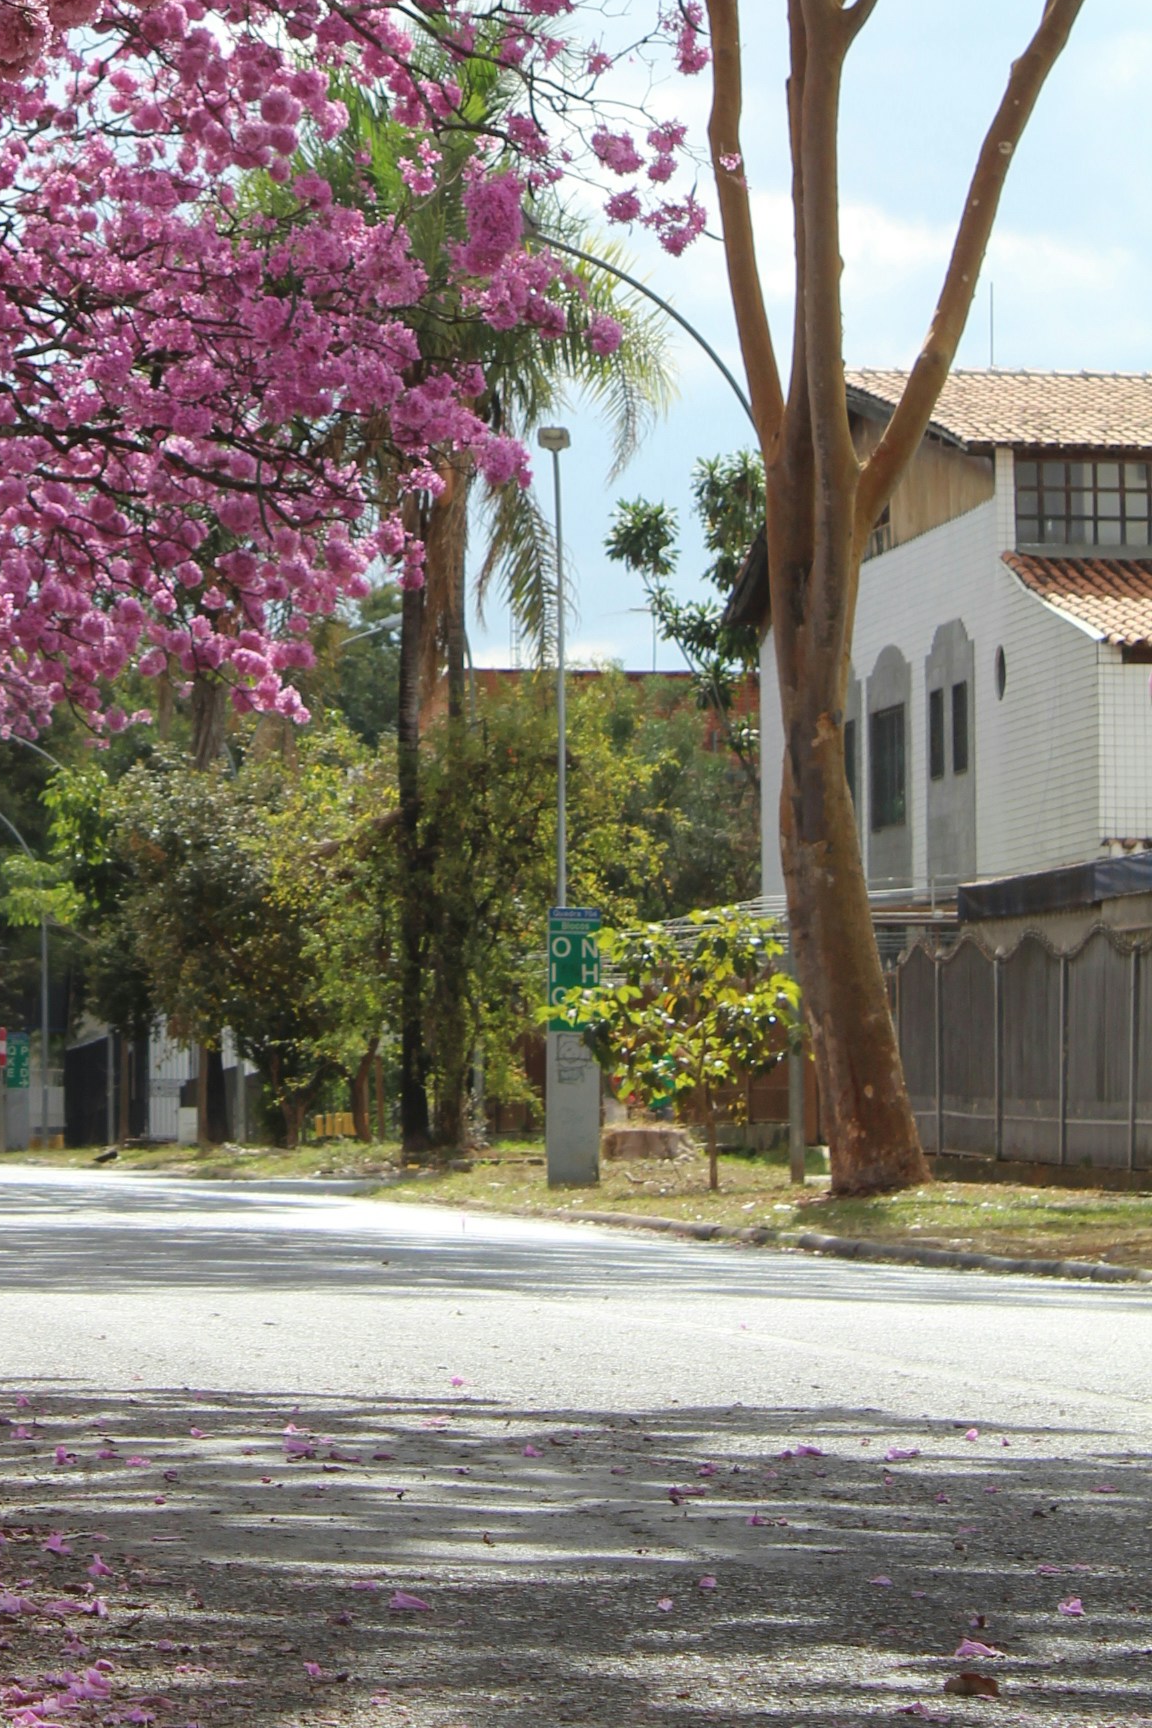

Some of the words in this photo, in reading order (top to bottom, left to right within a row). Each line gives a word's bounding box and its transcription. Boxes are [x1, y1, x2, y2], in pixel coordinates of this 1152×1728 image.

[561, 922, 590, 930] Blocos
[552, 936, 572, 958] O
[581, 938, 599, 959] N
[581, 963, 599, 983] H
[20, 1046, 29, 1056] P
[7, 1067, 15, 1078] E
[19, 1067, 29, 1078] D
